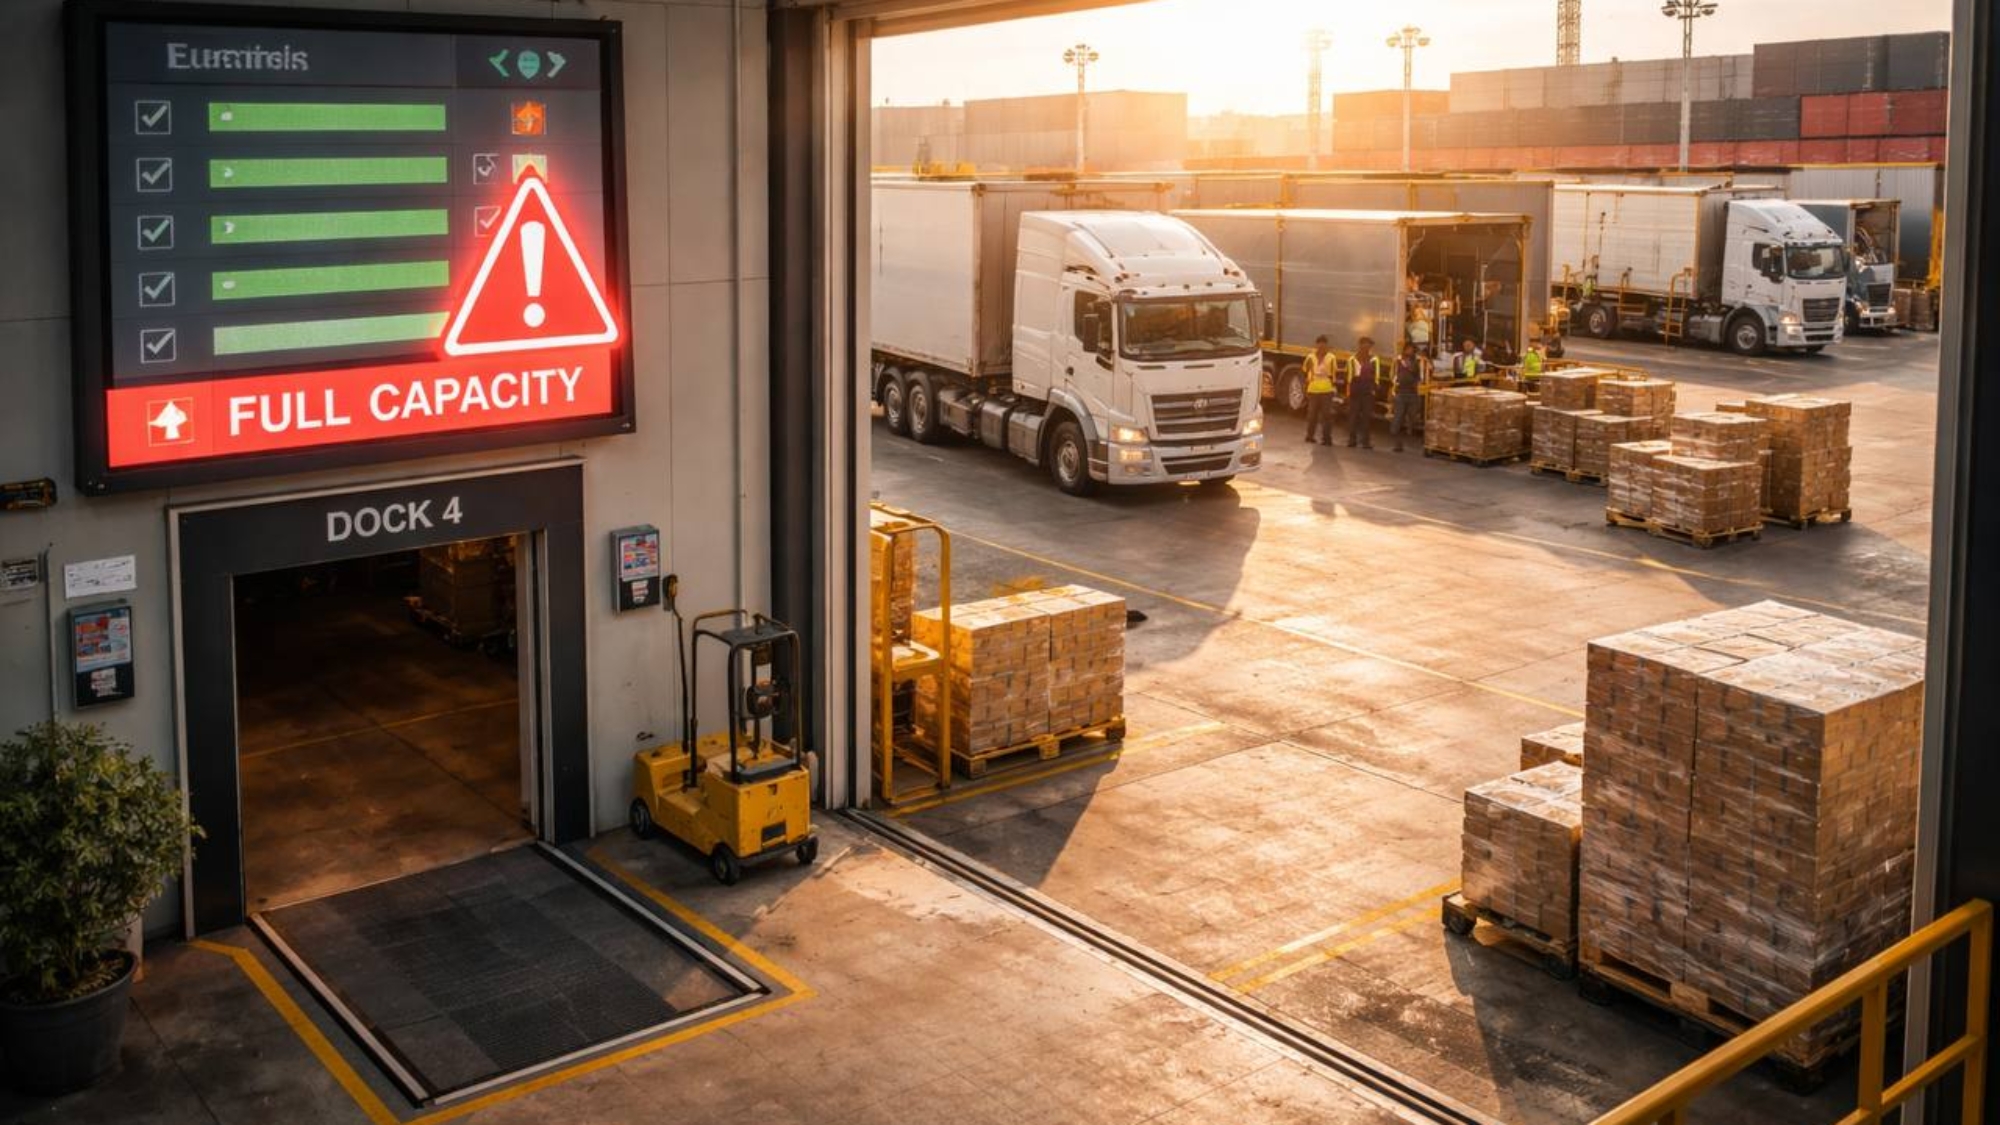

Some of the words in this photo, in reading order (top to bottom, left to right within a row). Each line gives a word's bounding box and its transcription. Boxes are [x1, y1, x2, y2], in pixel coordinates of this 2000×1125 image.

[229, 388, 351, 437] FULL
[369, 366, 583, 422] CAPACITY
[326, 499, 434, 542] DOCK
[442, 496, 463, 524] 4
